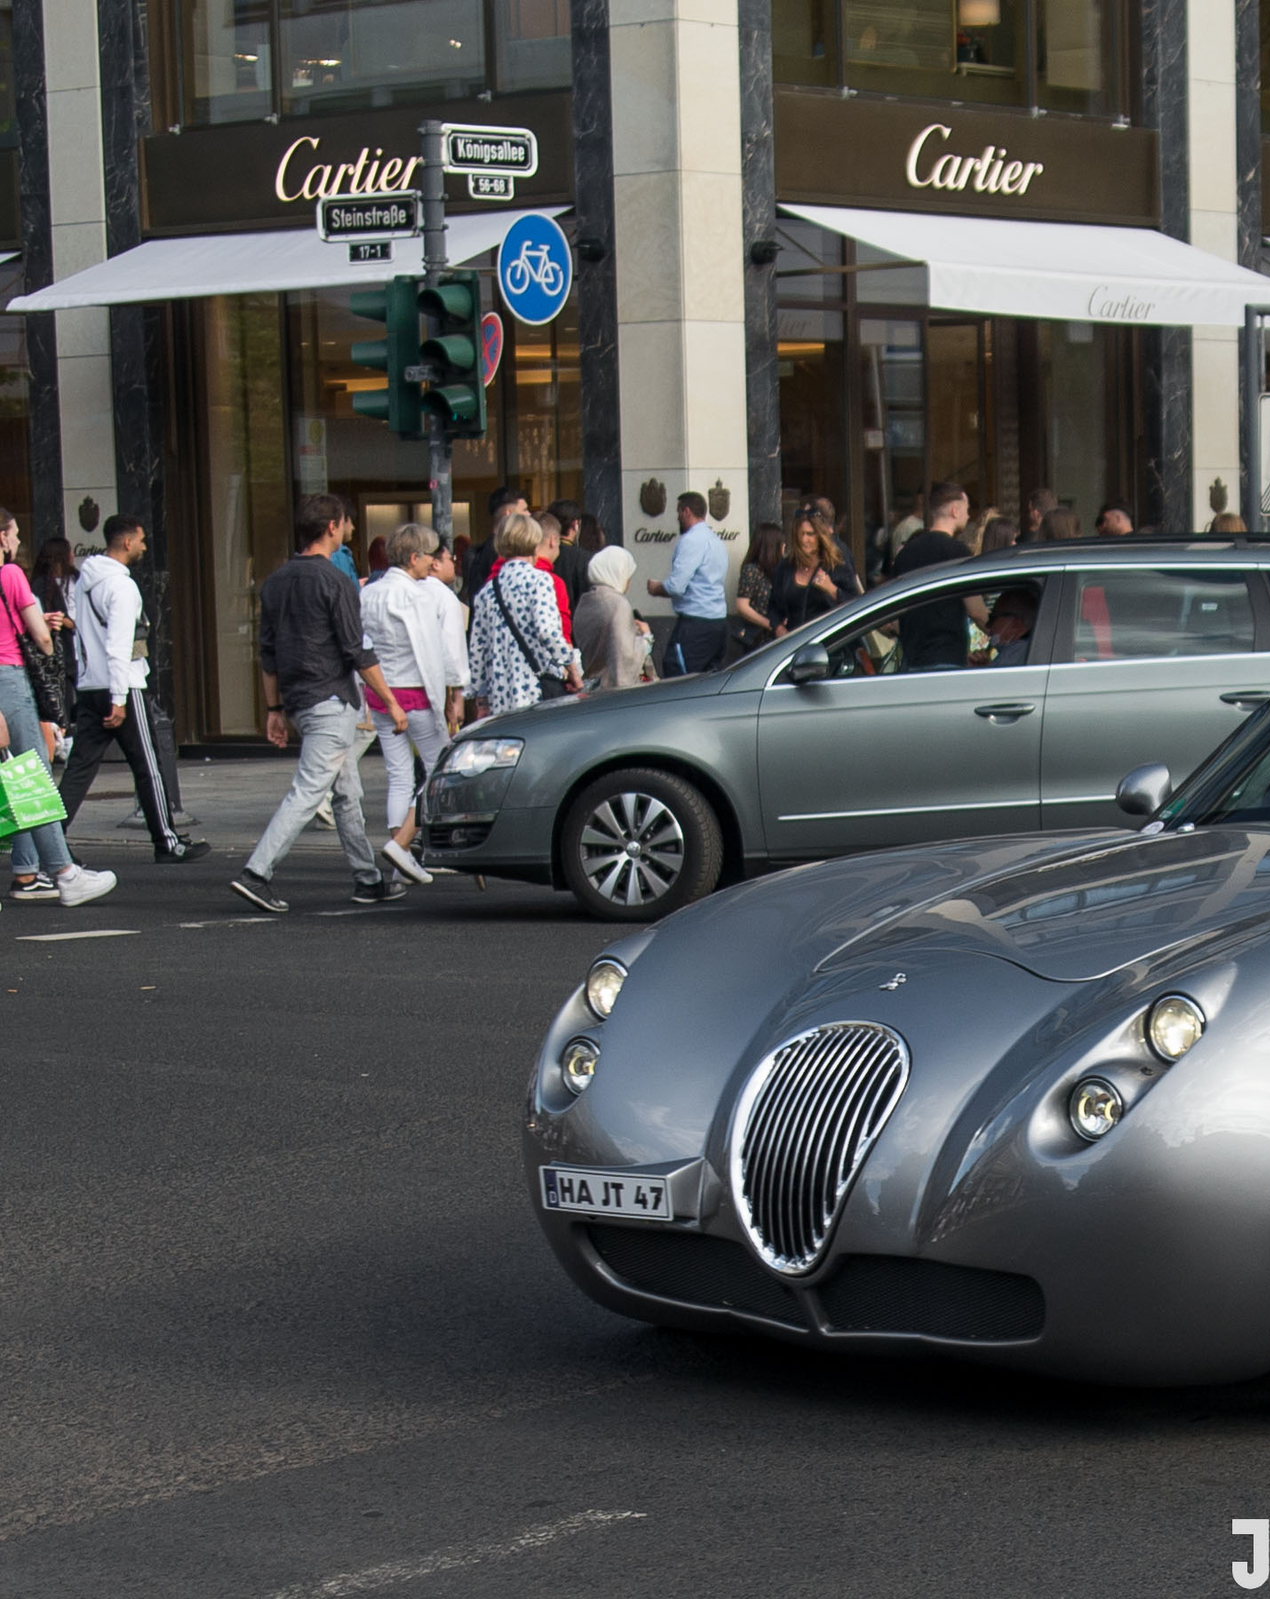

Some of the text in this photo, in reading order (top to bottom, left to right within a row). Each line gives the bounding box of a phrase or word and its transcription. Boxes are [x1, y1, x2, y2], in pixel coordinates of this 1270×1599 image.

[457, 138, 525, 163] Königsallee
[906, 124, 1044, 195] Cartier
[275, 136, 423, 200] Cartier
[478, 180, 506, 193] 56-68
[331, 204, 407, 229] Steinstraße
[359, 246, 382, 259] 17-1
[1087, 284, 1156, 320] Cartier
[634, 527, 677, 543] Cartier
[558, 1177, 664, 1211] HA JT 47
